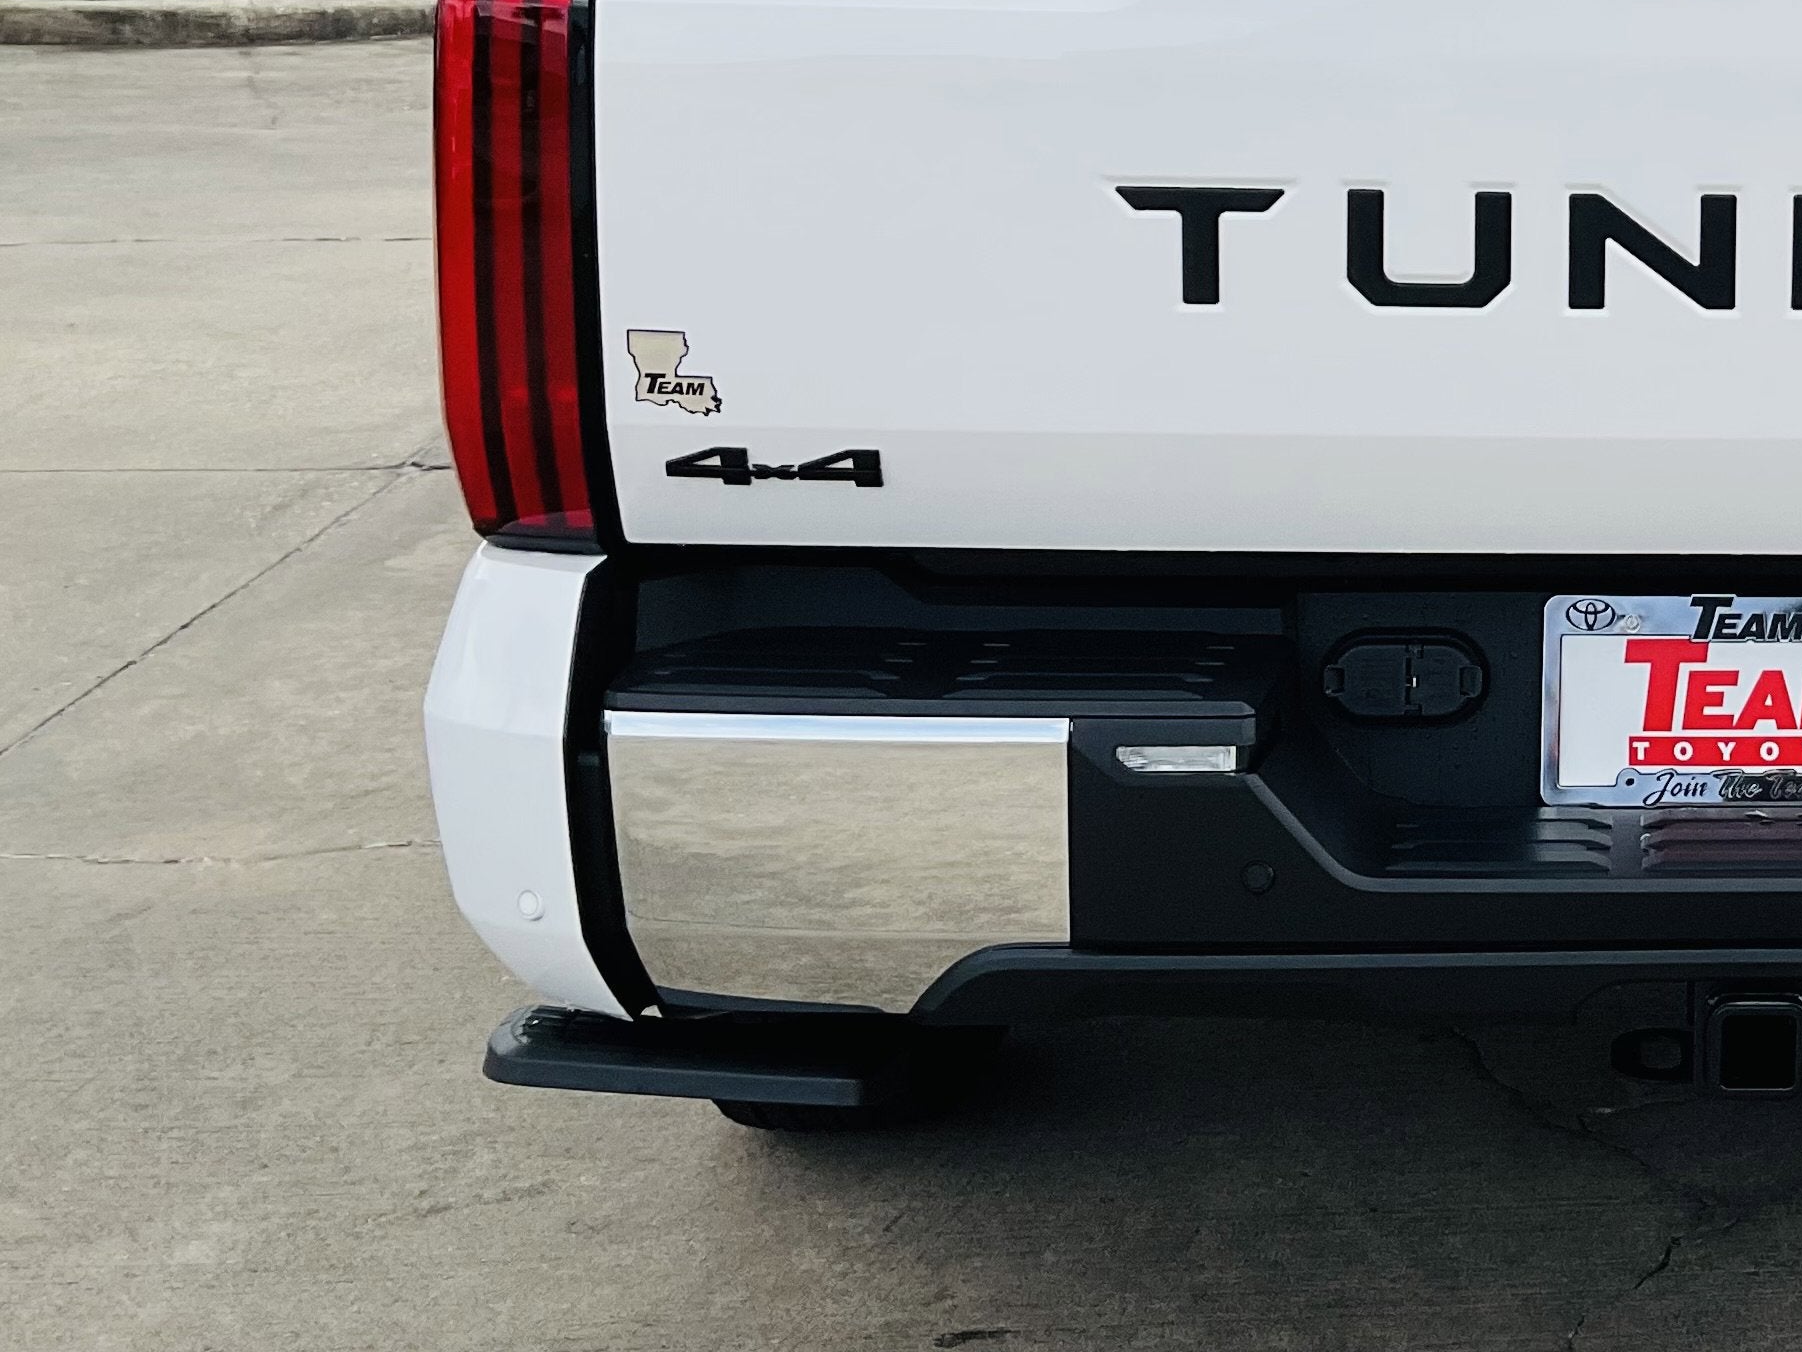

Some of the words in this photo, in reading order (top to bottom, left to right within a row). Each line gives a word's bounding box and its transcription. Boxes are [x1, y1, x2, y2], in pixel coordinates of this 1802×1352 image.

[644, 373, 705, 396] TEAM
[1642, 771, 1708, 806] Join
[1712, 771, 1763, 799] The
